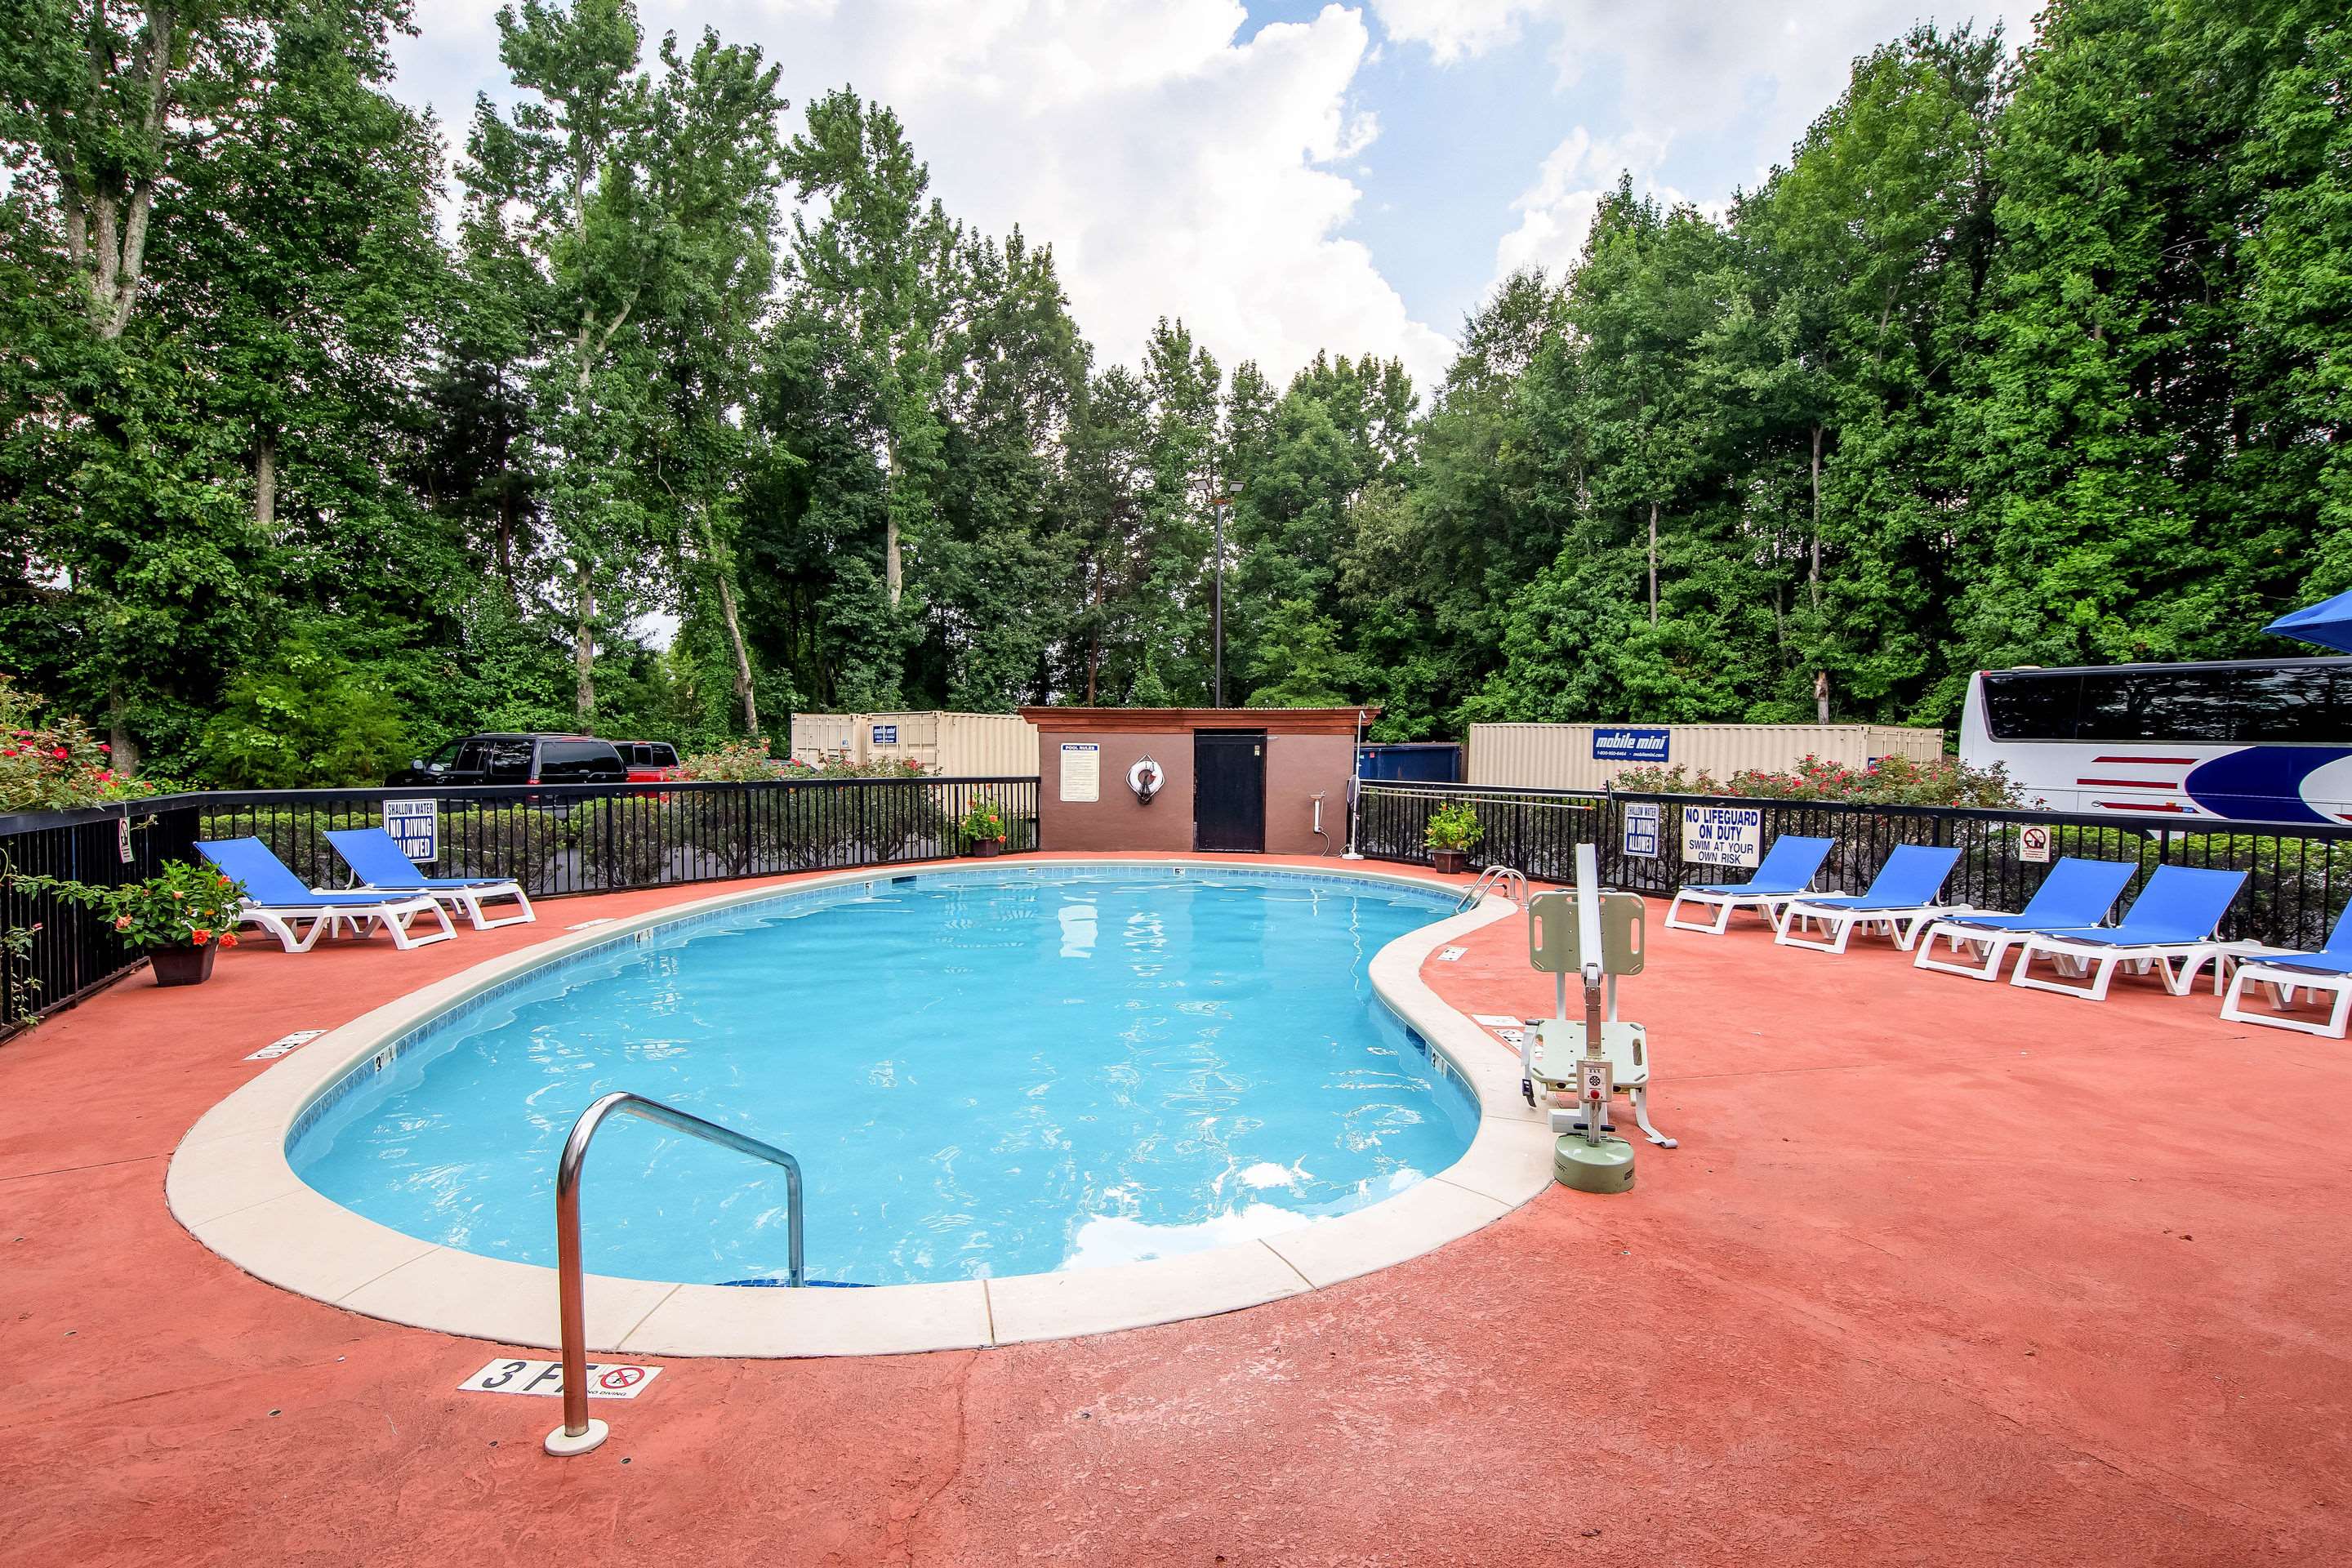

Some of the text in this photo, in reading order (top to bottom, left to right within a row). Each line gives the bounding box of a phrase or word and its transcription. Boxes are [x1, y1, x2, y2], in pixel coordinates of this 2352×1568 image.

[1596, 732, 1668, 750] mobile mini
[387, 803, 434, 816] SHALLOW WATER
[1628, 805, 1656, 817] SHALLOW WATER
[1686, 808, 1757, 826] NO LIFEGUARD
[390, 817, 432, 838] NO DIVING
[1628, 818, 1655, 835] NO DIVING
[1699, 824, 1742, 841] ON DUTY
[394, 838, 430, 858] LOWED
[1628, 835, 1653, 853] ALLOWED
[1689, 840, 1753, 854] SWIM AT YOUR
[1699, 851, 1741, 865] OWN RISK
[481, 1361, 528, 1388] 3
